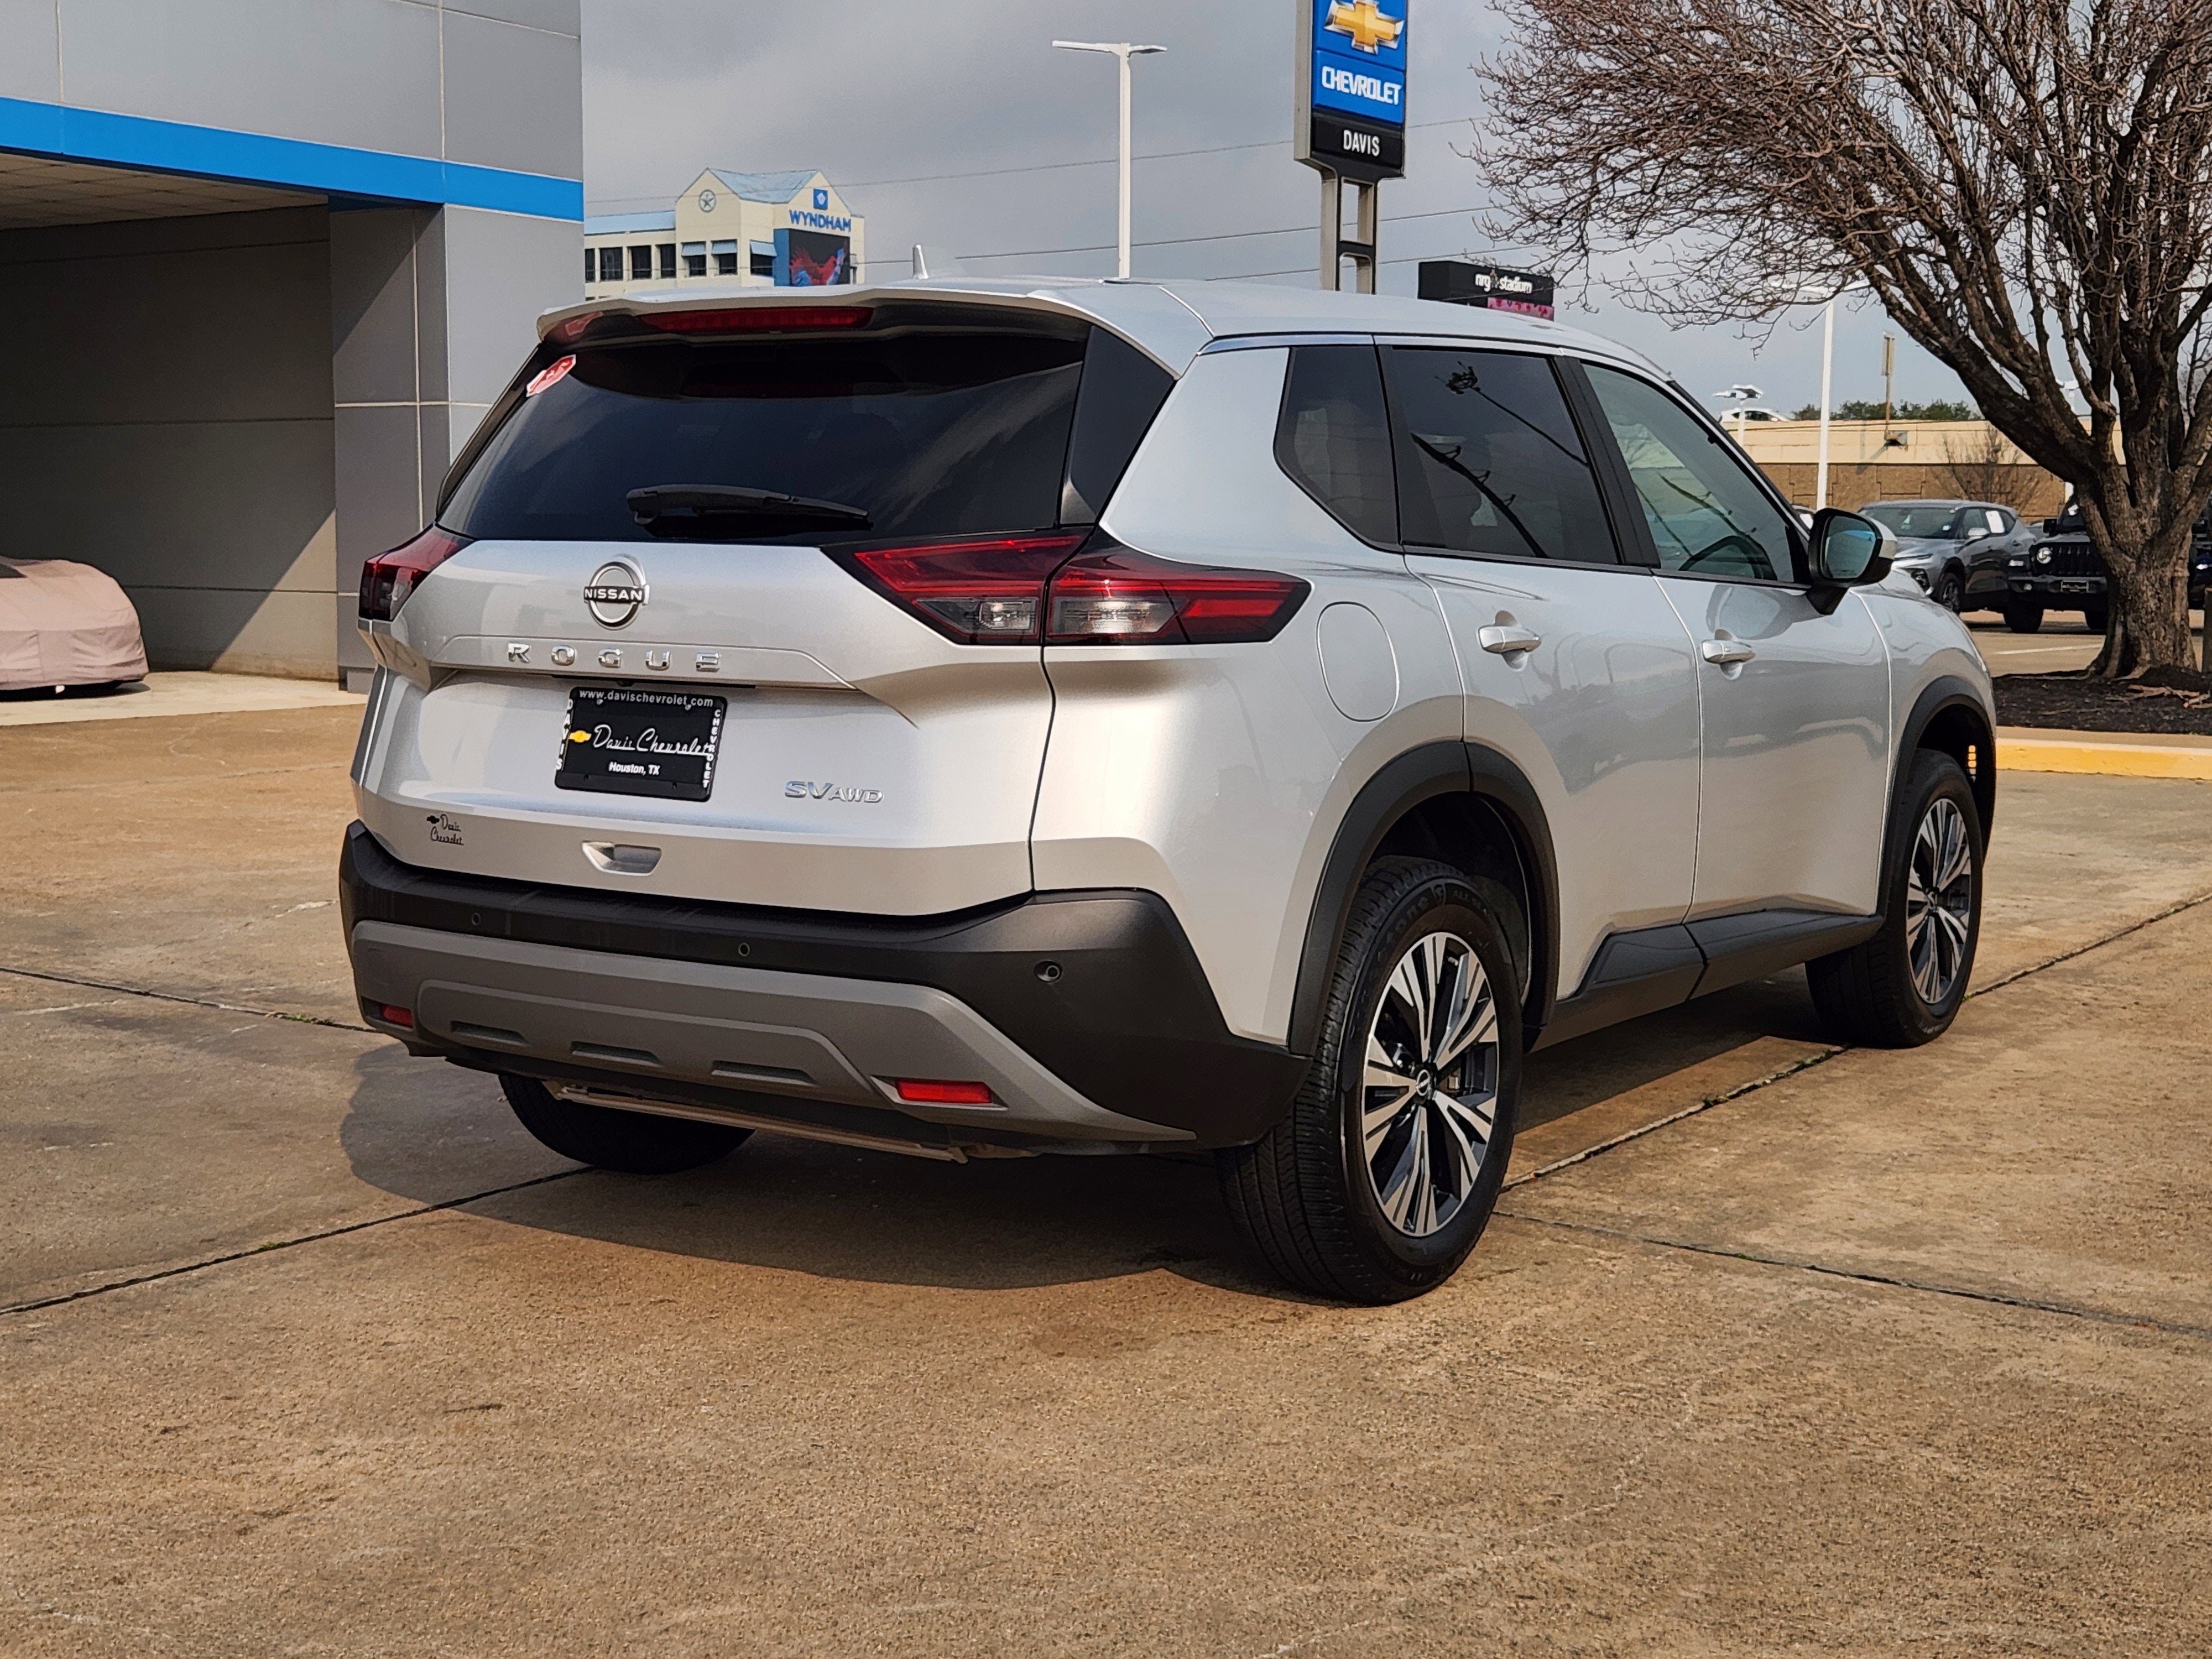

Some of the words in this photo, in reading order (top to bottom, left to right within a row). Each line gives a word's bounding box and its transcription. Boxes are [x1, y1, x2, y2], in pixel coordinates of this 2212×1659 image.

[1322, 66, 1402, 106] CHEVROLET
[1343, 129, 1380, 156] DAVIS
[789, 210, 852, 232] WYNDHAM
[1499, 275, 1532, 294] stadium
[584, 588, 643, 601] NISSAN
[507, 643, 721, 672] ROGUE
[556, 698, 573, 770] DAVIS
[593, 724, 635, 751] Davis
[636, 728, 710, 756] Chevrolet
[702, 709, 722, 789] CHEVROLET
[608, 761, 646, 776] Houston,
[648, 764, 661, 775] TX
